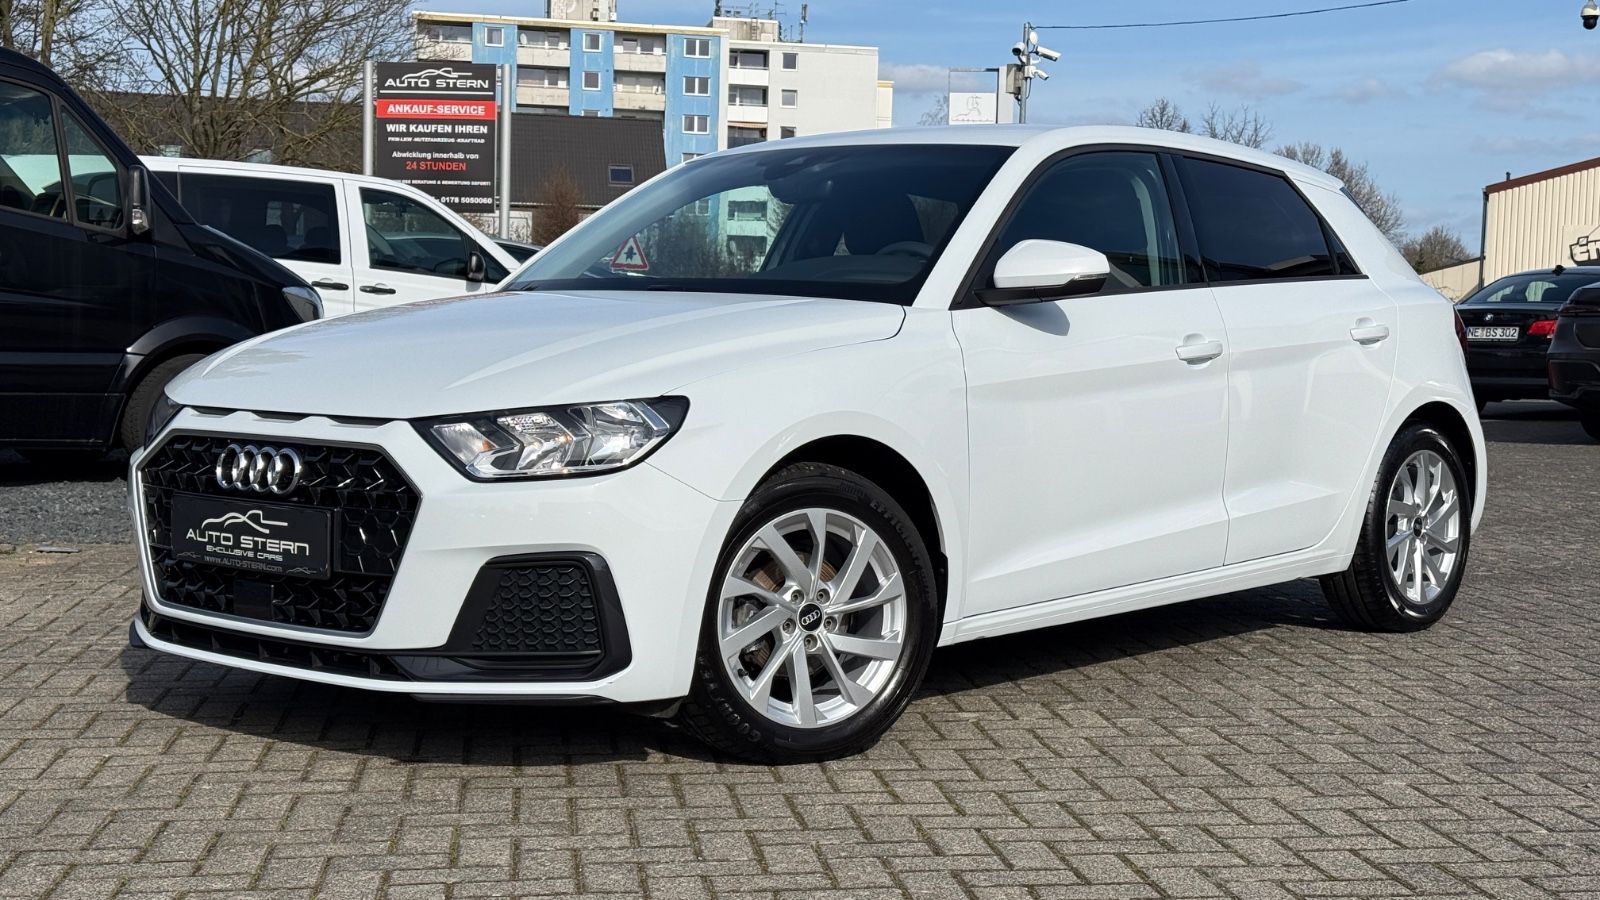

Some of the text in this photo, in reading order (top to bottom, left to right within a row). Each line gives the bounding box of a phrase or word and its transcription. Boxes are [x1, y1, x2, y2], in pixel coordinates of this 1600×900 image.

[385, 78, 489, 88] AUTO STERN
[387, 104, 485, 114] ANKAUF-SERVICE
[386, 124, 488, 133] WIR KAUFEN IHREN
[392, 151, 431, 160] Abwicklung
[406, 161, 467, 171] 24 STUNDEN
[460, 196, 493, 204] 5050060
[1467, 327, 1517, 337] NE BS 302
[186, 528, 310, 556] AUTO STERN
[206, 544, 284, 562] EXCLUSIVE CARS
